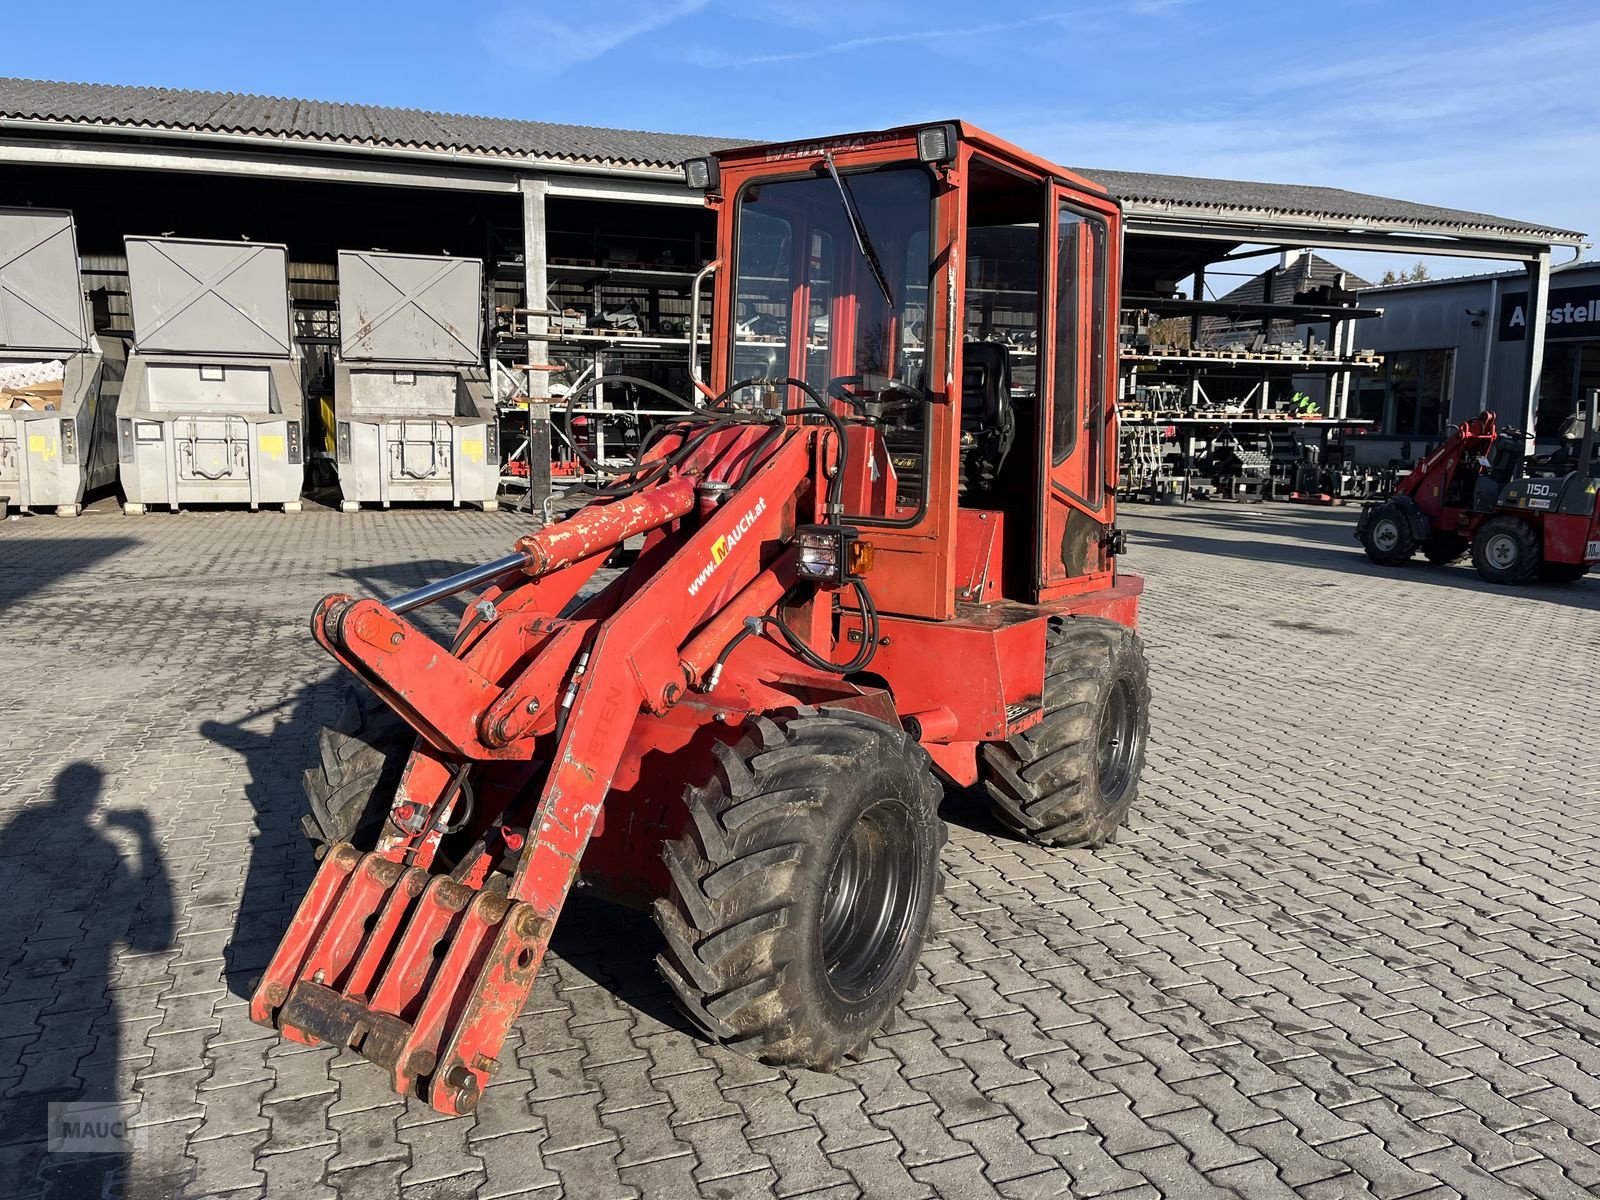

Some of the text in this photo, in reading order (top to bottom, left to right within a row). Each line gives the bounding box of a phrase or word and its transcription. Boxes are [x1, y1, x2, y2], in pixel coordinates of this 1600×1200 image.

[1509, 300, 1600, 327] Astell
[1526, 483, 1550, 496] 1150
[687, 496, 767, 597] www.MAUCH.at
